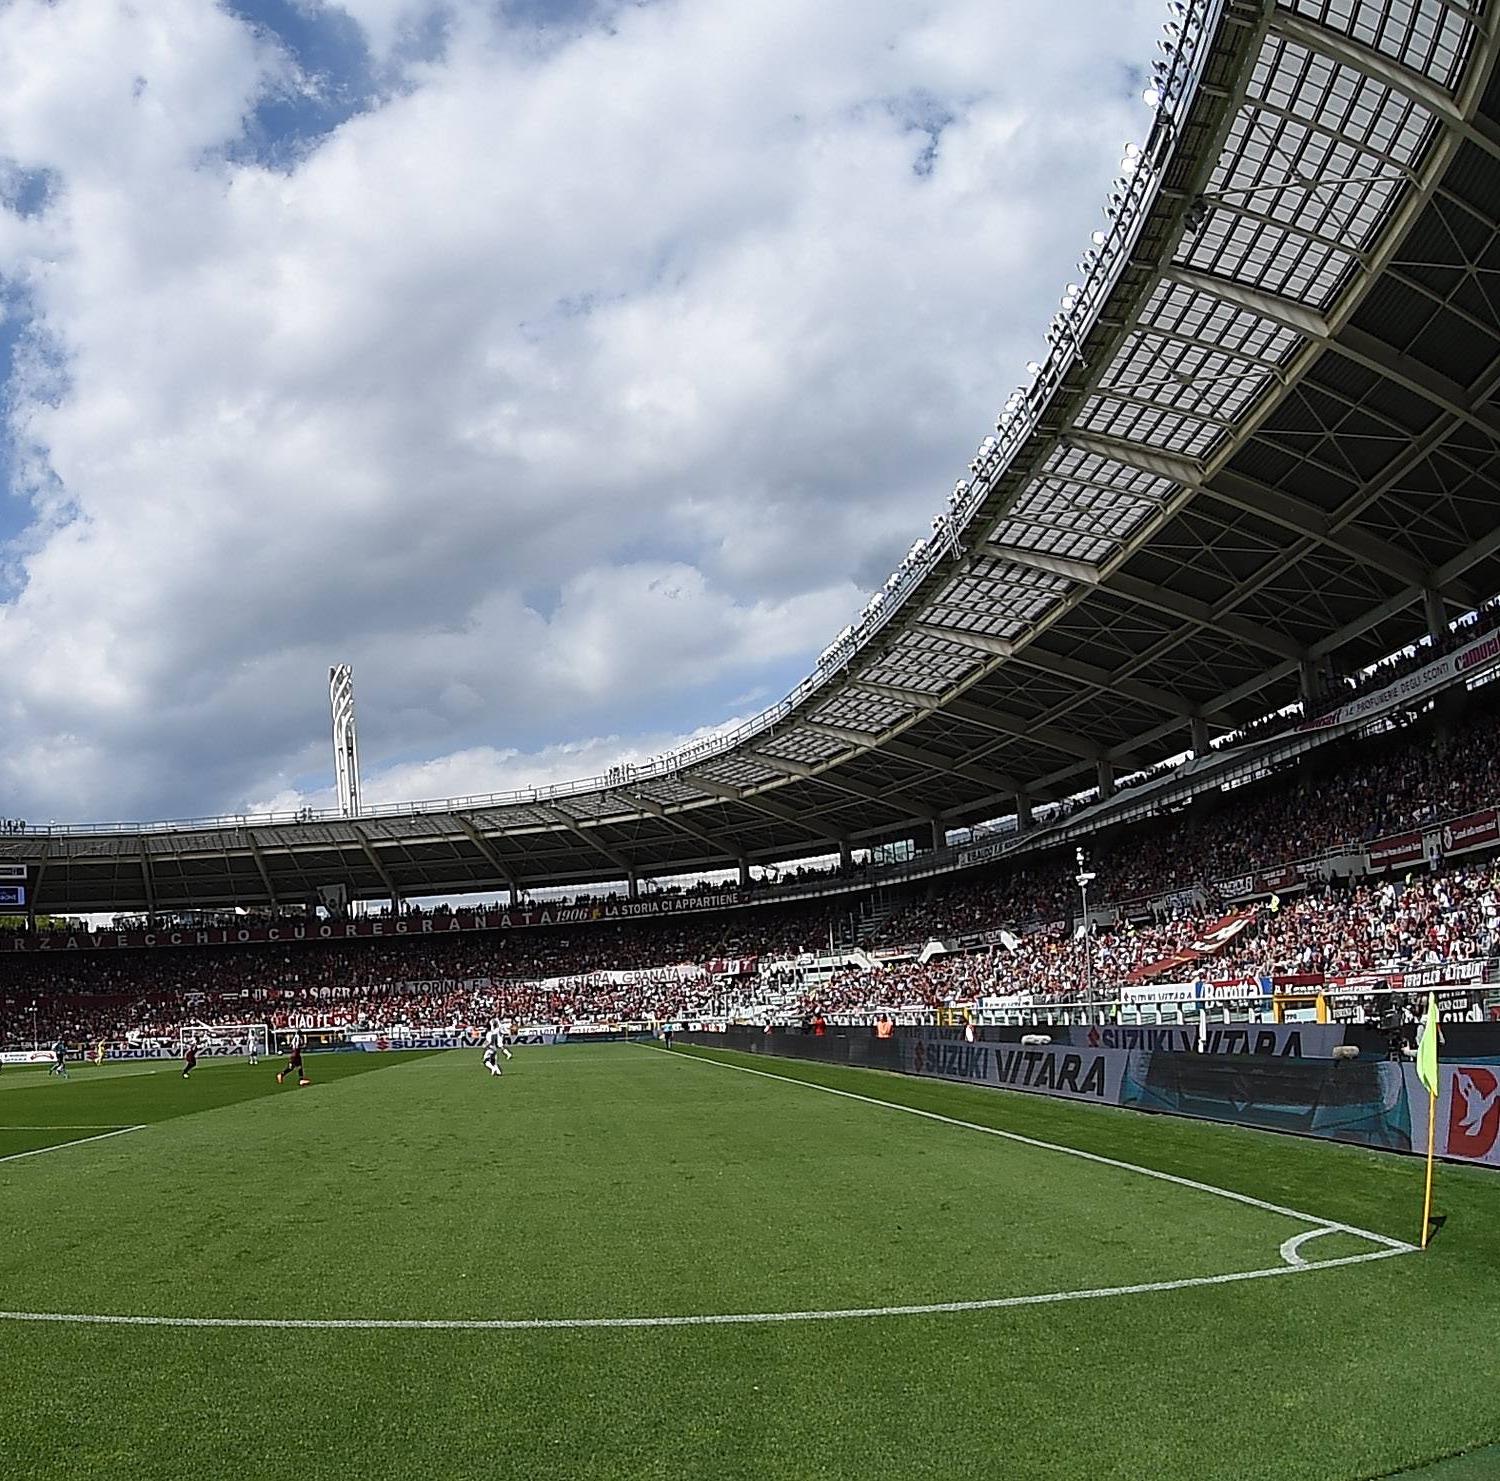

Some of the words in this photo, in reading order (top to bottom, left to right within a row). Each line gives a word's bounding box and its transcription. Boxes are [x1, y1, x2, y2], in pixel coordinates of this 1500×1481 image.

[1422, 663, 1449, 684] SCONTI
[555, 907, 588, 922] 1906
[605, 906, 619, 917] LA
[621, 902, 658, 915] STORIA
[661, 900, 673, 912] CI
[676, 892, 739, 910] APPARTIENE
[622, 968, 680, 984] GRANATA
[288, 1014, 314, 1028] CIAO
[392, 1038, 457, 1049] SUZUKI
[106, 1050, 161, 1059] SUZUKI
[167, 1046, 243, 1058] VARA
[926, 1044, 988, 1079] SUZUKI
[996, 1049, 1105, 1097] VITARA
